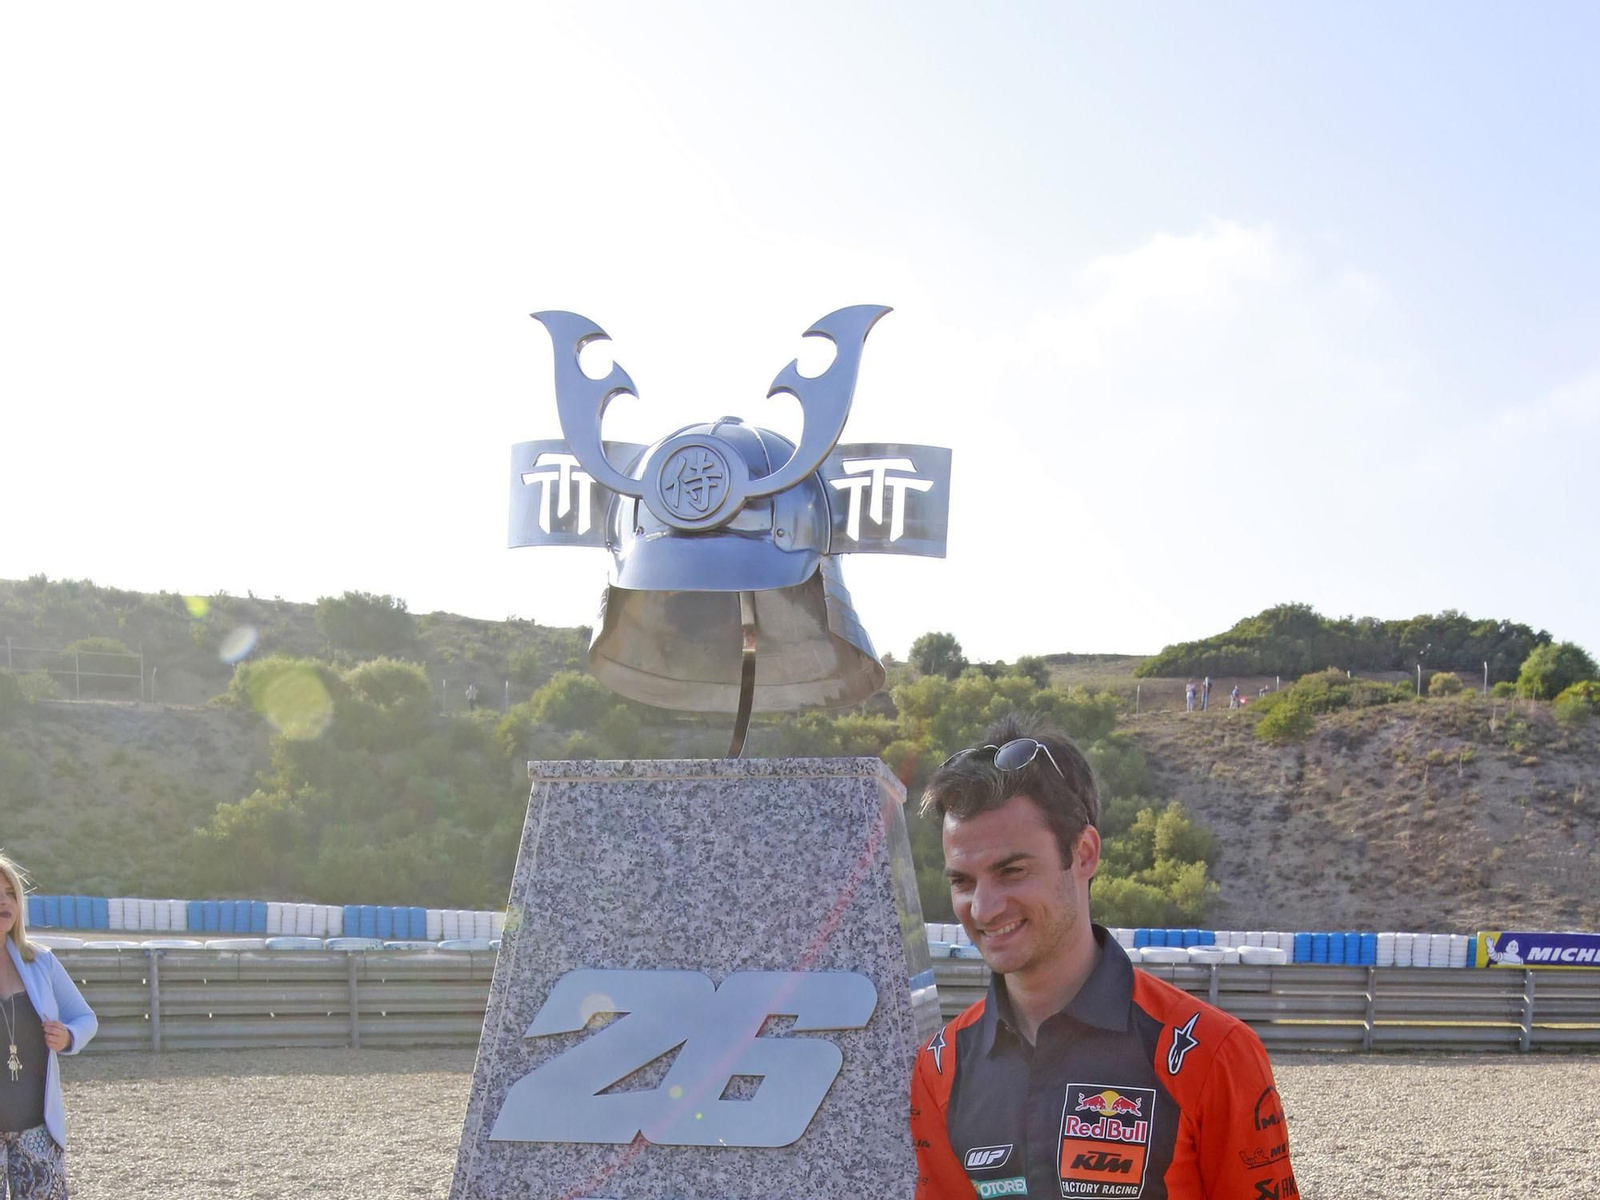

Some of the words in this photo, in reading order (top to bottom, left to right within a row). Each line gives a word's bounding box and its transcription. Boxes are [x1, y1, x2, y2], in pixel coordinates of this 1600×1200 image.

[665, 451, 723, 511] 侍
[488, 969, 878, 1147] 26
[1064, 1115, 1106, 1138] Red
[1106, 1118, 1148, 1143] Bull
[967, 1149, 1005, 1167] WP
[1070, 1150, 1133, 1174] KTM
[1062, 1181, 1100, 1194] FACTORY
[1102, 1184, 1138, 1195] RACING
